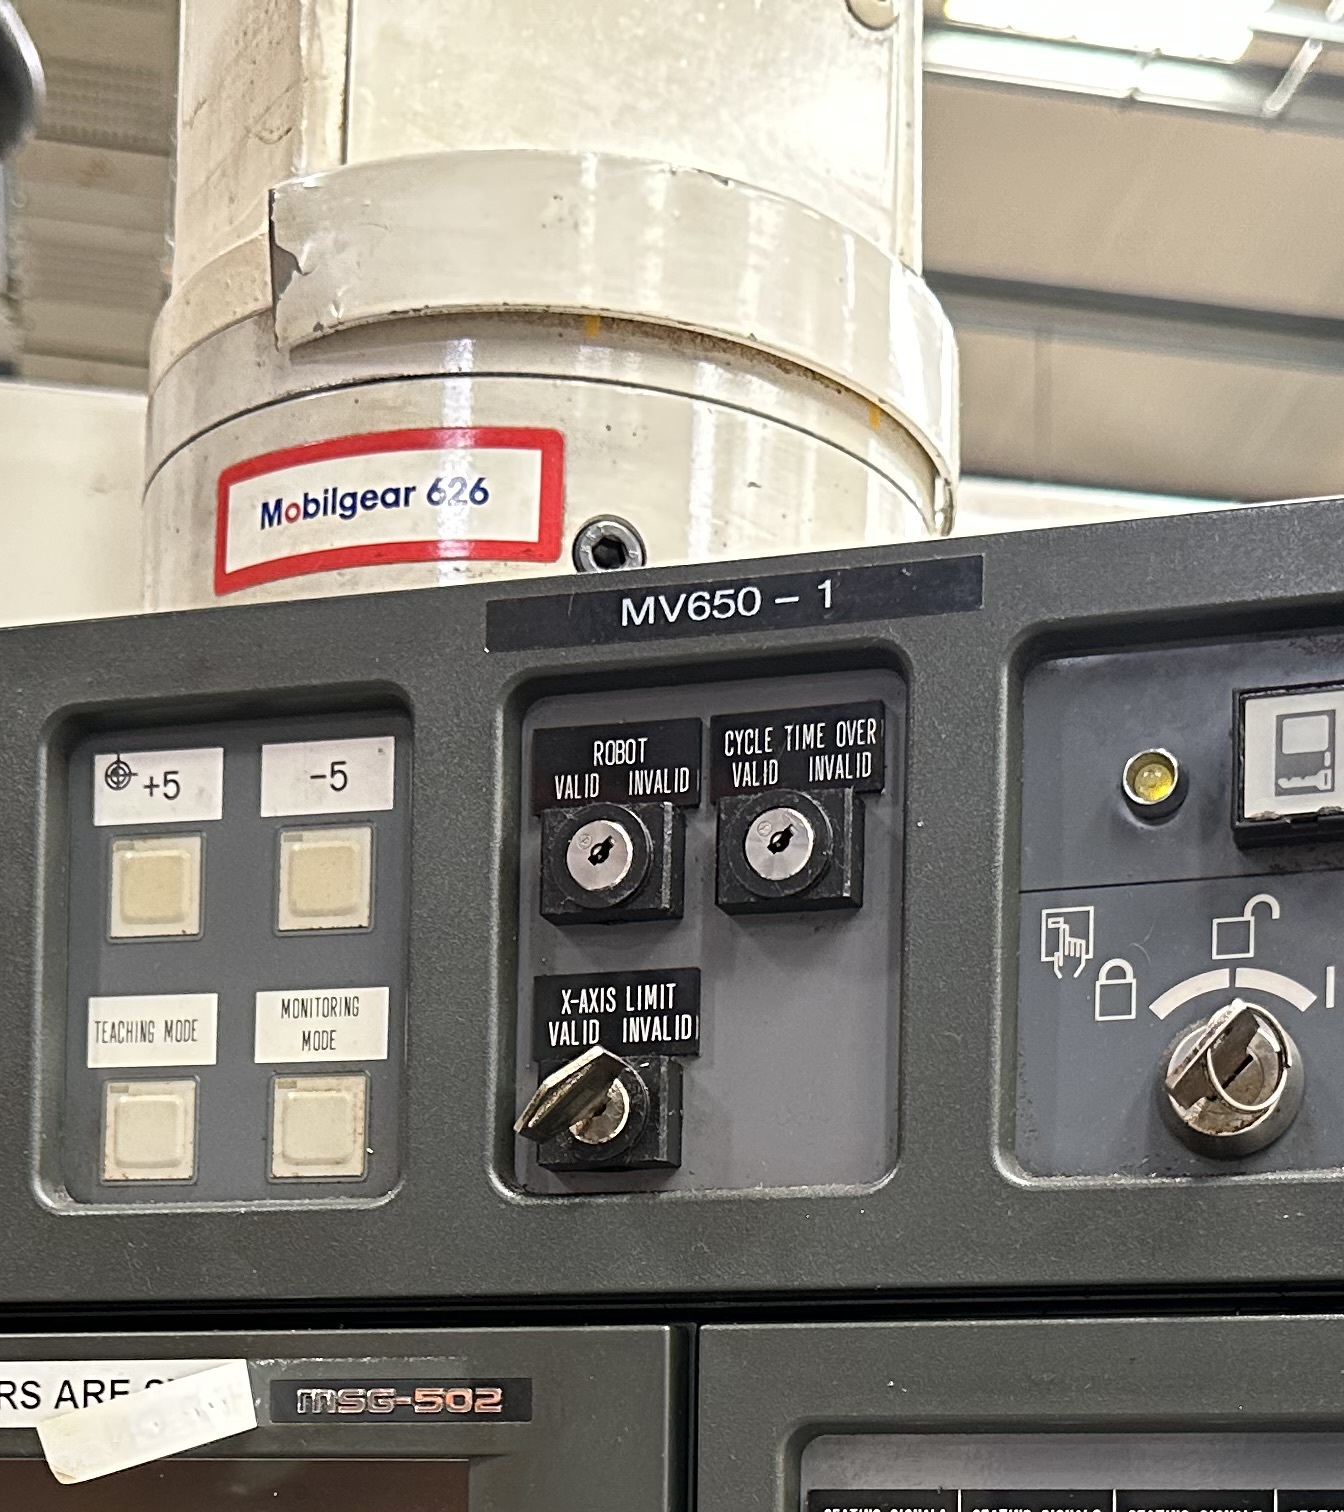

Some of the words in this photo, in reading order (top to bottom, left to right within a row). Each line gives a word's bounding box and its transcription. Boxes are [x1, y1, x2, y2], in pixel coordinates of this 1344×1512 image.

[260, 483, 416, 530] Mobilgear
[426, 477, 489, 506] 626
[621, 586, 761, 627] MV650
[817, 581, 834, 609] 1
[593, 738, 648, 766] ROBOT
[724, 727, 773, 756] CYCLE
[784, 723, 825, 751] TIME
[836, 718, 877, 746] OVER
[144, 770, 180, 800] +5
[310, 761, 348, 792] -5
[555, 774, 599, 799] VALID
[628, 768, 690, 795] INVALID
[732, 760, 778, 788] VALID
[809, 752, 872, 782] INVALID
[281, 996, 360, 1019] MONITORING
[561, 988, 617, 1014] X-AXIS
[625, 983, 676, 1012] LIMIT
[95, 1020, 155, 1044] TEACHING
[164, 1020, 198, 1042] MODE
[302, 1031, 336, 1051] MODE
[548, 1020, 600, 1046] VALID
[622, 1014, 693, 1043] INVALID
[55, 1380, 130, 1409] ARE
